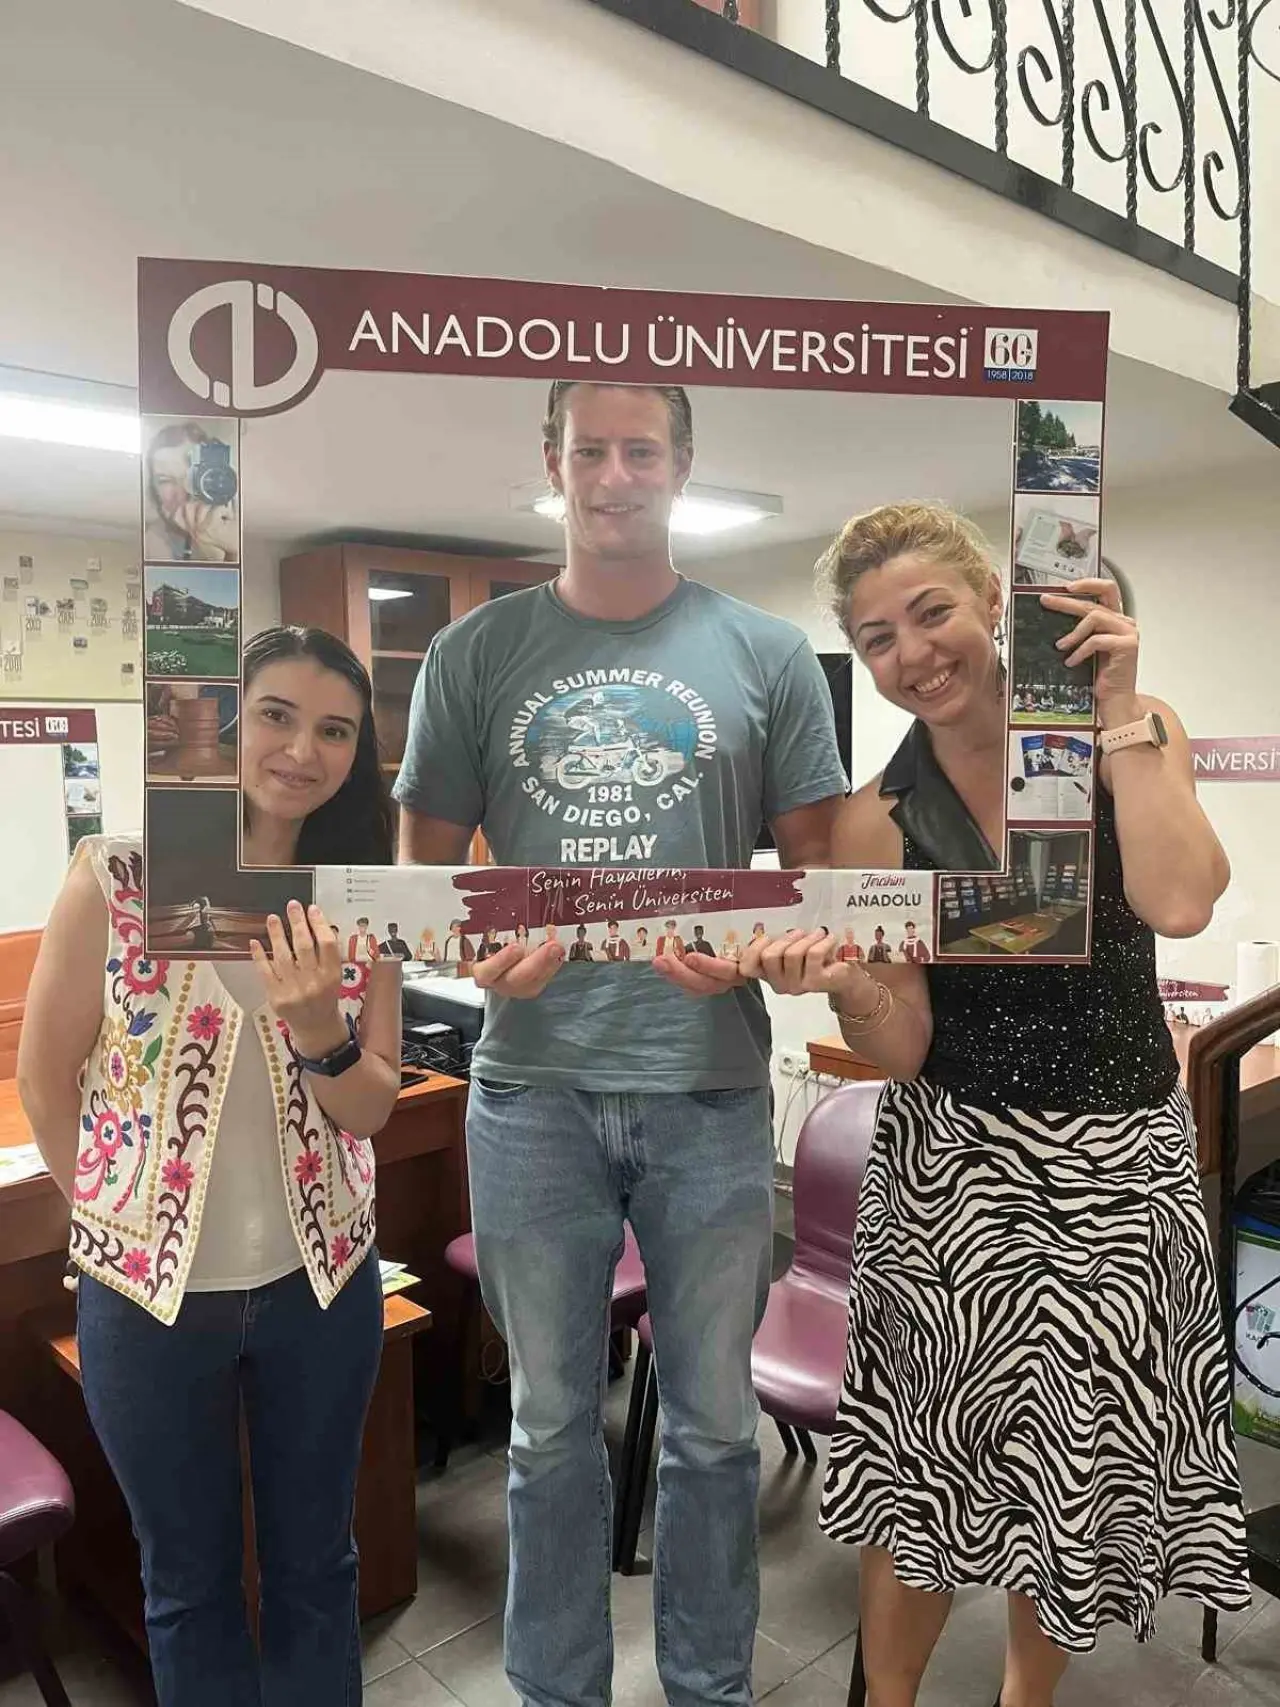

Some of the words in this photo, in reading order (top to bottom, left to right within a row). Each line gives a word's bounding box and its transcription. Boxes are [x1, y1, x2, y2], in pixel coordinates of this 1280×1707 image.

[349, 309, 630, 364] ANADOLU
[647, 315, 967, 379] ÜNİVERSİTESİ
[508, 691, 553, 768] ANNUAL
[552, 668, 664, 695] SUMMER
[665, 679, 718, 760] REUNION
[1191, 747, 1280, 771] NİVERSİ
[521, 776, 560, 815] SAN
[563, 804, 651, 827] DIEGO,
[656, 772, 704, 810] CAL.
[587, 784, 633, 803] 1981
[560, 834, 658, 863] REPLAY
[531, 871, 581, 893] Senin
[574, 894, 624, 916] Senin
[632, 885, 733, 911] Üniversiten
[846, 894, 921, 907] ANADOLU
